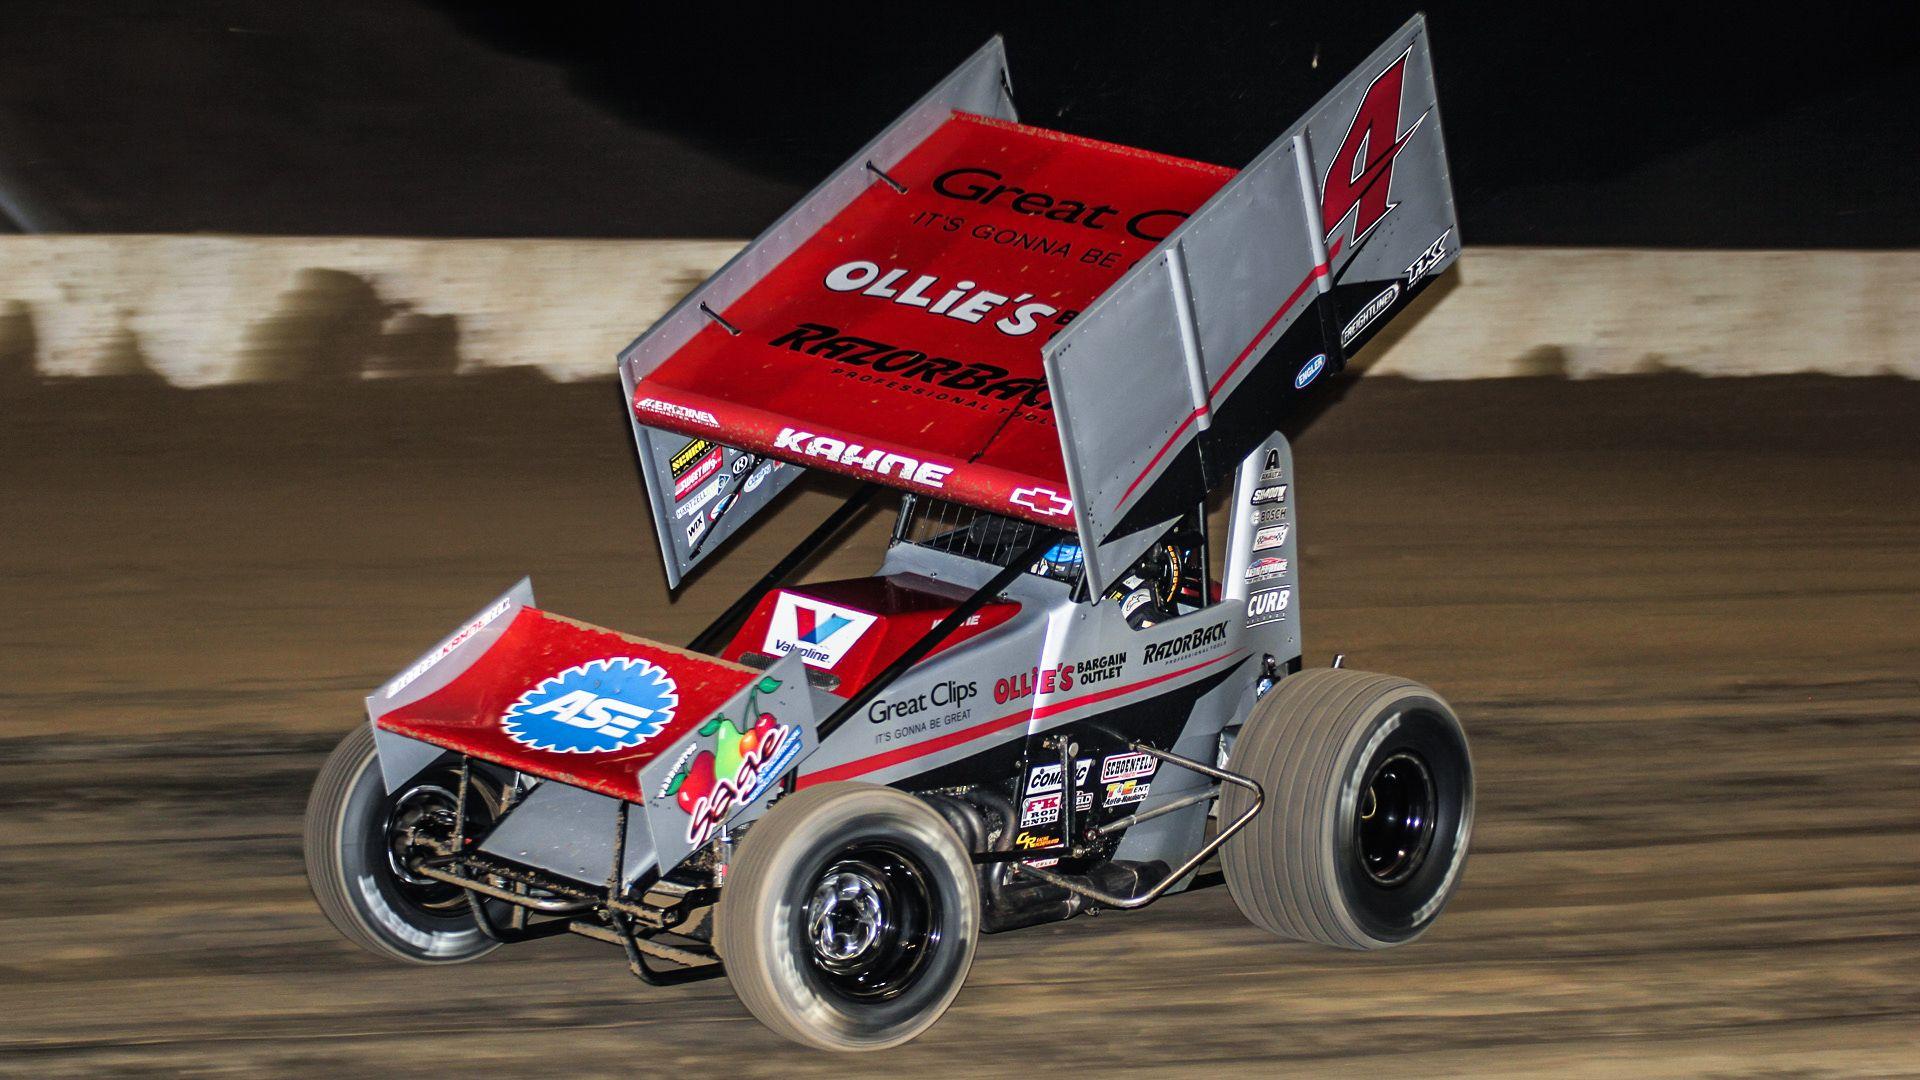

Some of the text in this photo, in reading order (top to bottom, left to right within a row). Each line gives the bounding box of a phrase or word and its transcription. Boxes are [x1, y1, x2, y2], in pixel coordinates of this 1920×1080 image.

[1321, 45, 1431, 248] 4
[932, 167, 1119, 230] Great
[912, 211, 965, 233] IT'S
[972, 223, 1071, 260] GONNA
[1079, 247, 1122, 269] BE
[823, 260, 1060, 336] OLLiE'S
[1343, 290, 1394, 344] FREIGHTLINER
[768, 322, 1052, 411] RAZORBAC
[1297, 357, 1325, 387] ENGLER
[831, 367, 989, 411] PROFESSIONAL
[774, 427, 954, 488] KAHNE
[687, 516, 703, 537] WIX
[1260, 507, 1287, 522] BOSCH
[1247, 590, 1290, 618] CURB
[775, 639, 830, 663] Valoline
[1077, 652, 1127, 674] BARGAIN
[1165, 640, 1227, 665] PROFESSIONAL TOOLS
[993, 661, 1075, 705] OLLiE'S
[1080, 665, 1123, 685] OUTLET
[530, 689, 655, 738] ASE
[868, 680, 978, 725] Great Clips
[875, 709, 972, 745] IT'S GONNA BE GREAT
[1105, 757, 1154, 776] SCHOENFELD
[1022, 815, 1056, 827] ENDS
[1027, 797, 1059, 812] FK
[1030, 808, 1057, 818] ROD
